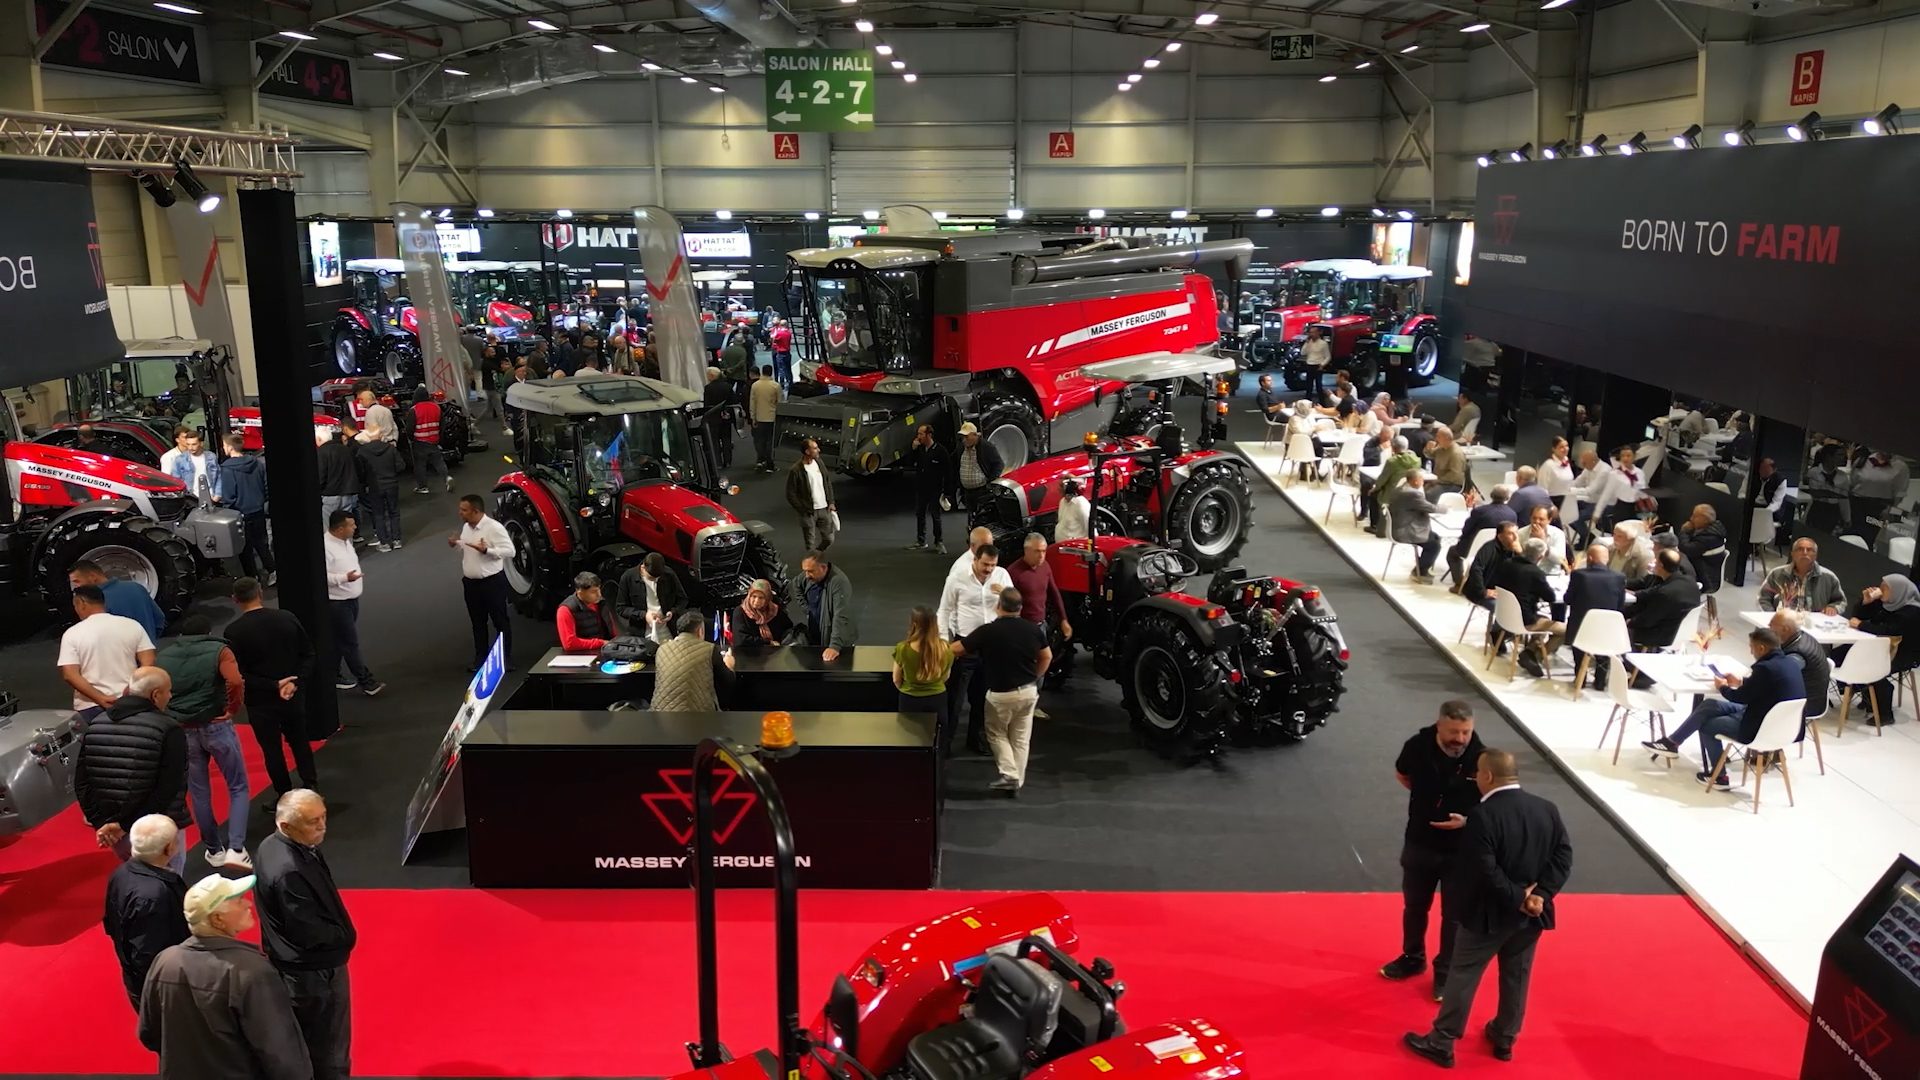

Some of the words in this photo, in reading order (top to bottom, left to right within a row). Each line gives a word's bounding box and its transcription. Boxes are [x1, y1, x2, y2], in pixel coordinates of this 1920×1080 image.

[107, 30, 160, 61] SALON
[769, 56, 820, 71] SALON
[833, 56, 872, 72] HALL
[1799, 56, 1815, 90] B
[780, 135, 796, 152] A
[1055, 134, 1070, 151] A
[1621, 219, 1686, 253] BORN
[1695, 221, 1728, 256] TO
[1737, 222, 1841, 265] FARM
[1090, 320, 1124, 336] MASSEY
[1125, 309, 1167, 327] FERGUSON
[1056, 369, 1080, 382] ACTI
[28, 465, 64, 477] MASSEY
[65, 473, 112, 489] FERGUSON
[595, 856, 687, 869] MASSEY
[712, 856, 811, 868] ERGUSN
[1816, 1015, 1854, 1055] MASSEY
[1854, 1053, 1882, 1080] FERG
